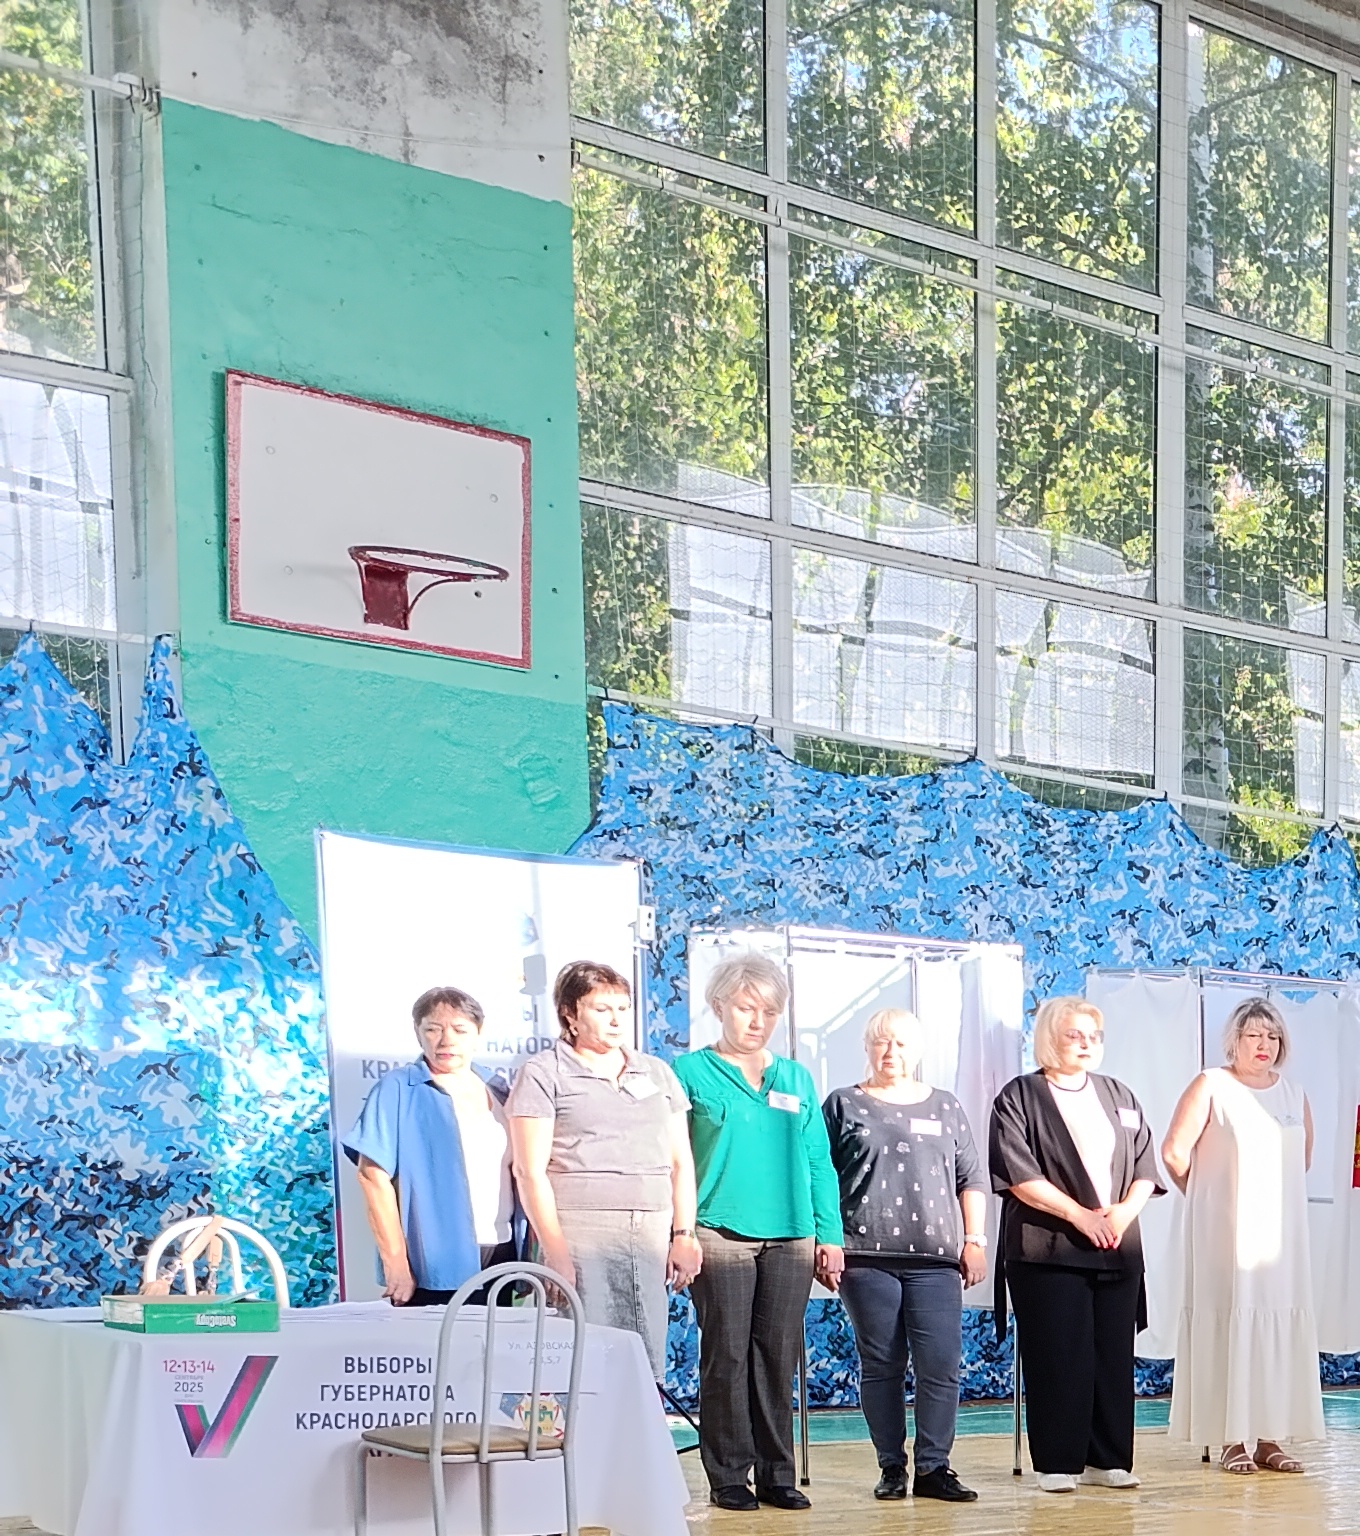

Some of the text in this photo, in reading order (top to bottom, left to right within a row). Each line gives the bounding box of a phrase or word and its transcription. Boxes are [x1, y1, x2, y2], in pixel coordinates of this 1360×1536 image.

[344, 1357, 432, 1374] ВЫБОРЫ
[174, 1382, 204, 1393] 2025
[320, 1384, 455, 1401] ГУБЕРНАТОА
[296, 1412, 477, 1430] КРАСНОДАРСОГО
